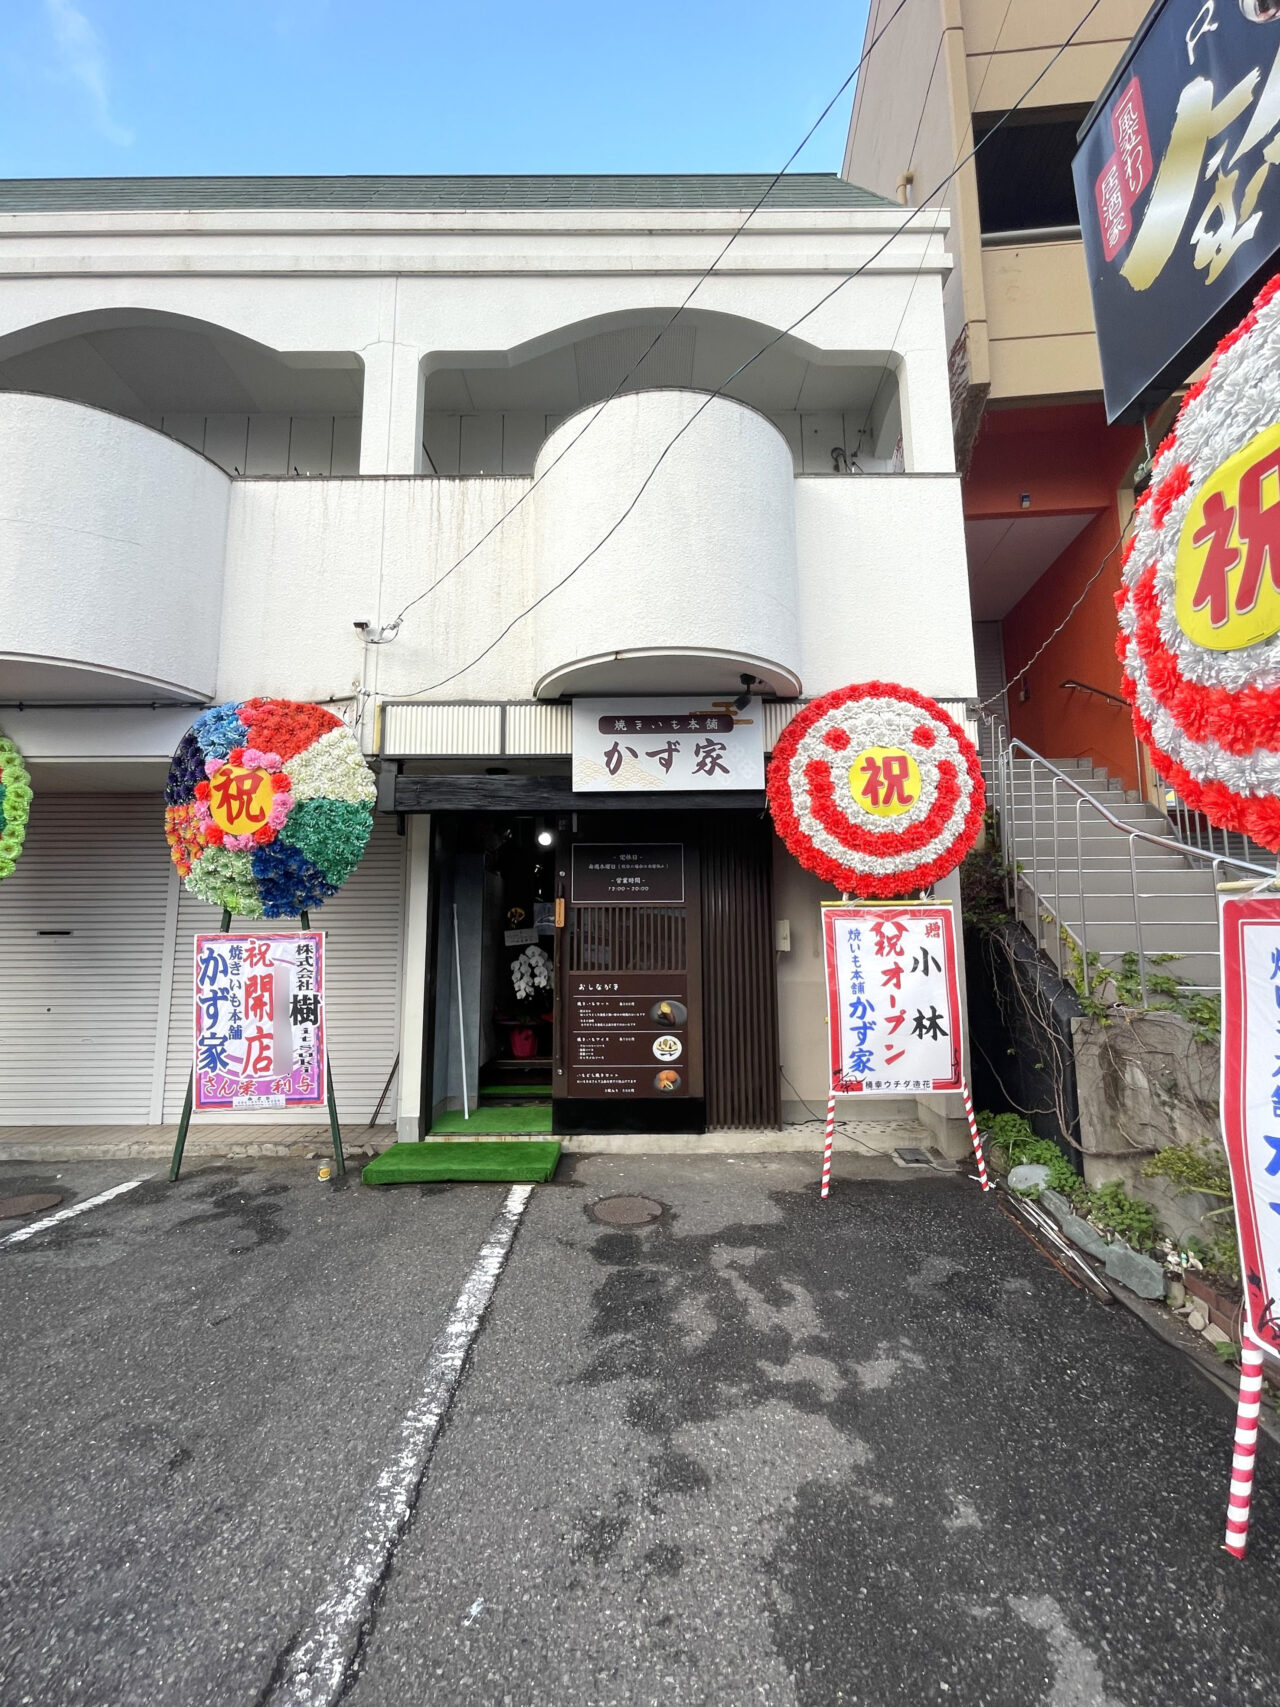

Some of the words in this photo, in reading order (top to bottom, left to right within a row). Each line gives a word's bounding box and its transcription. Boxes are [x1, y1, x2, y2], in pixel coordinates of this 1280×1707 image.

[614, 718, 718, 731] 焼きいも本舗
[603, 737, 731, 776] かず家
[860, 755, 915, 808] 祝
[213, 768, 266, 826] 祝
[198, 947, 230, 1073] かず家
[228, 945, 243, 1041] 焼きいも本舗
[241, 940, 274, 1077] 祝開店
[578, 983, 619, 991] おしながき
[910, 945, 949, 1042] 小林
